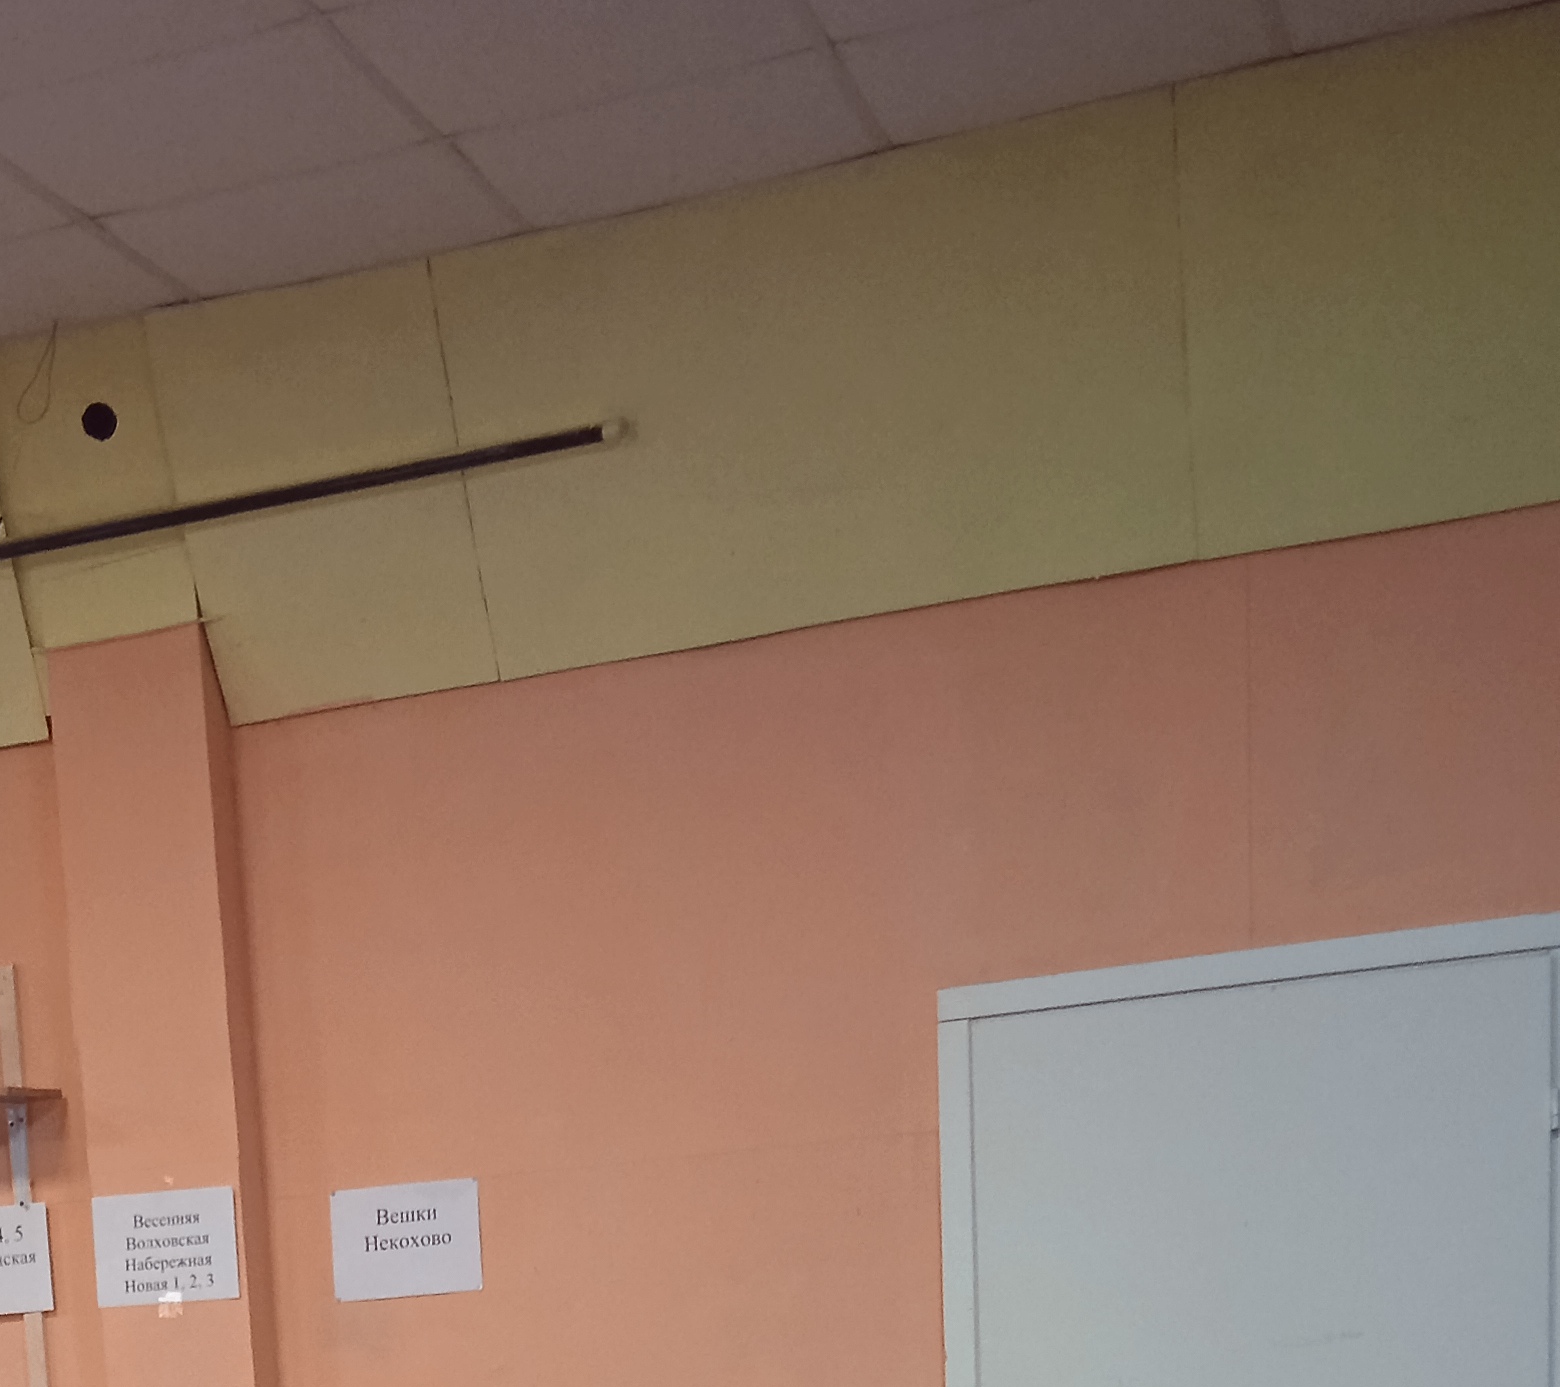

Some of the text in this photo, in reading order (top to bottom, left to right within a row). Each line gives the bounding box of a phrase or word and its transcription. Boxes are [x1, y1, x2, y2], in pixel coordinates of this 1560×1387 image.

[133, 1213, 201, 1230] Весенняя
[376, 1208, 438, 1226] Вешки
[14, 1225, 24, 1242] 5
[126, 1234, 210, 1251] Волховская
[364, 1232, 453, 1253] Некохово
[125, 1255, 213, 1273] Набережная
[125, 1280, 169, 1294] Новая
[207, 1273, 215, 1287] 3
